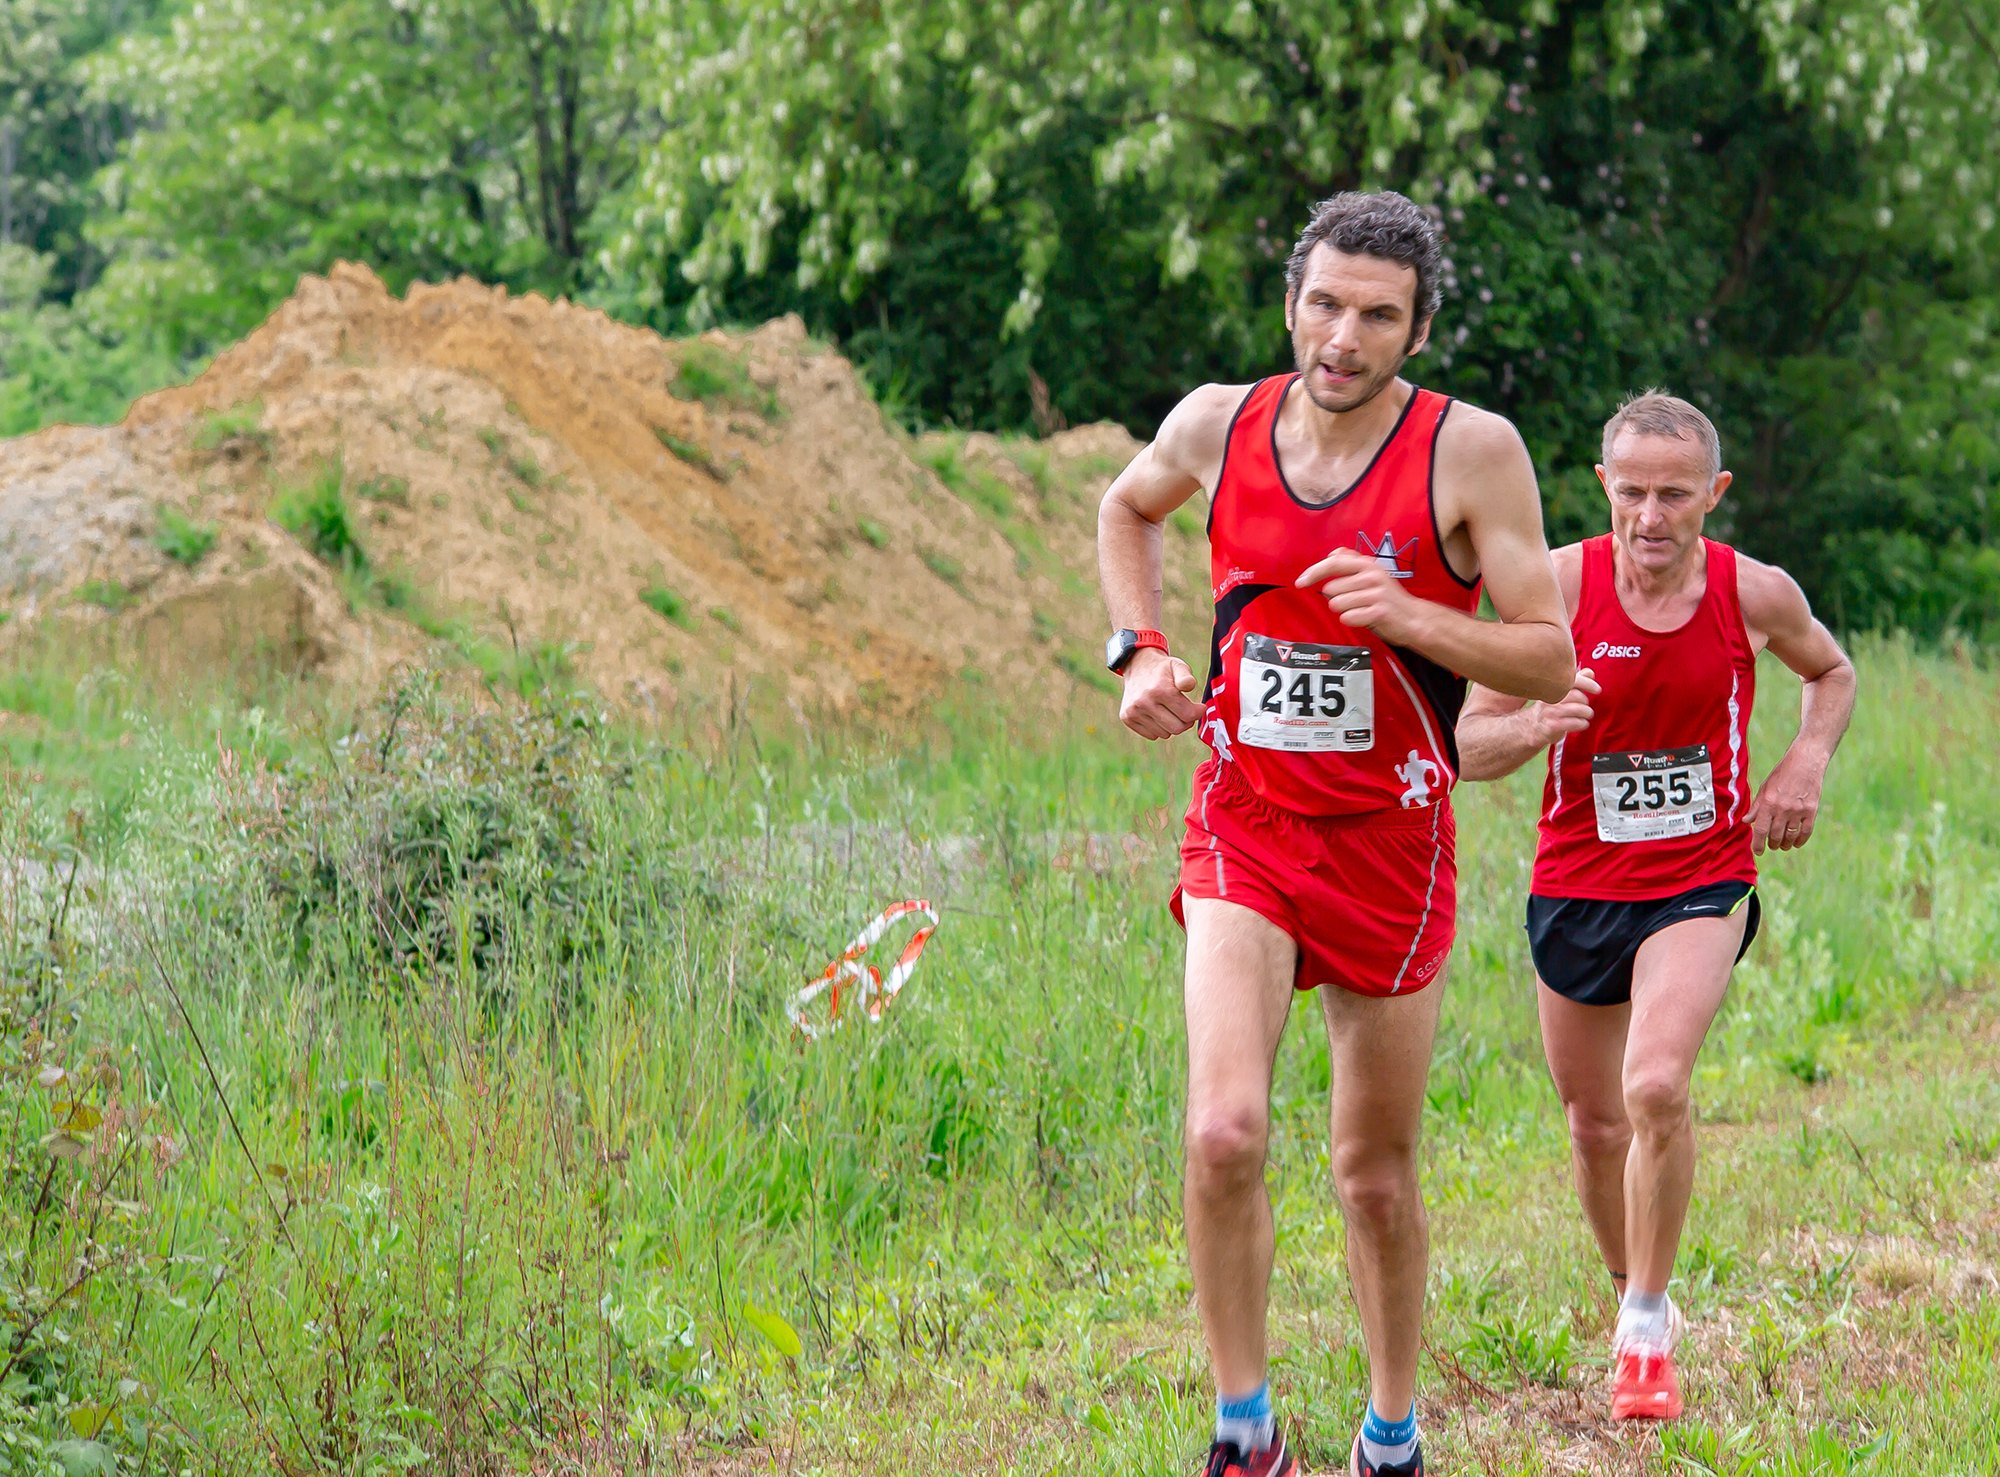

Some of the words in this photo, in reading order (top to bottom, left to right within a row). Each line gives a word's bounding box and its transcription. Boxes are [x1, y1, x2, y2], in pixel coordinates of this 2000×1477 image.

[1607, 645, 1641, 658] asics
[1261, 669, 1346, 717] 245
[1616, 770, 1692, 811] 255
[1416, 950, 1443, 977] GORE
